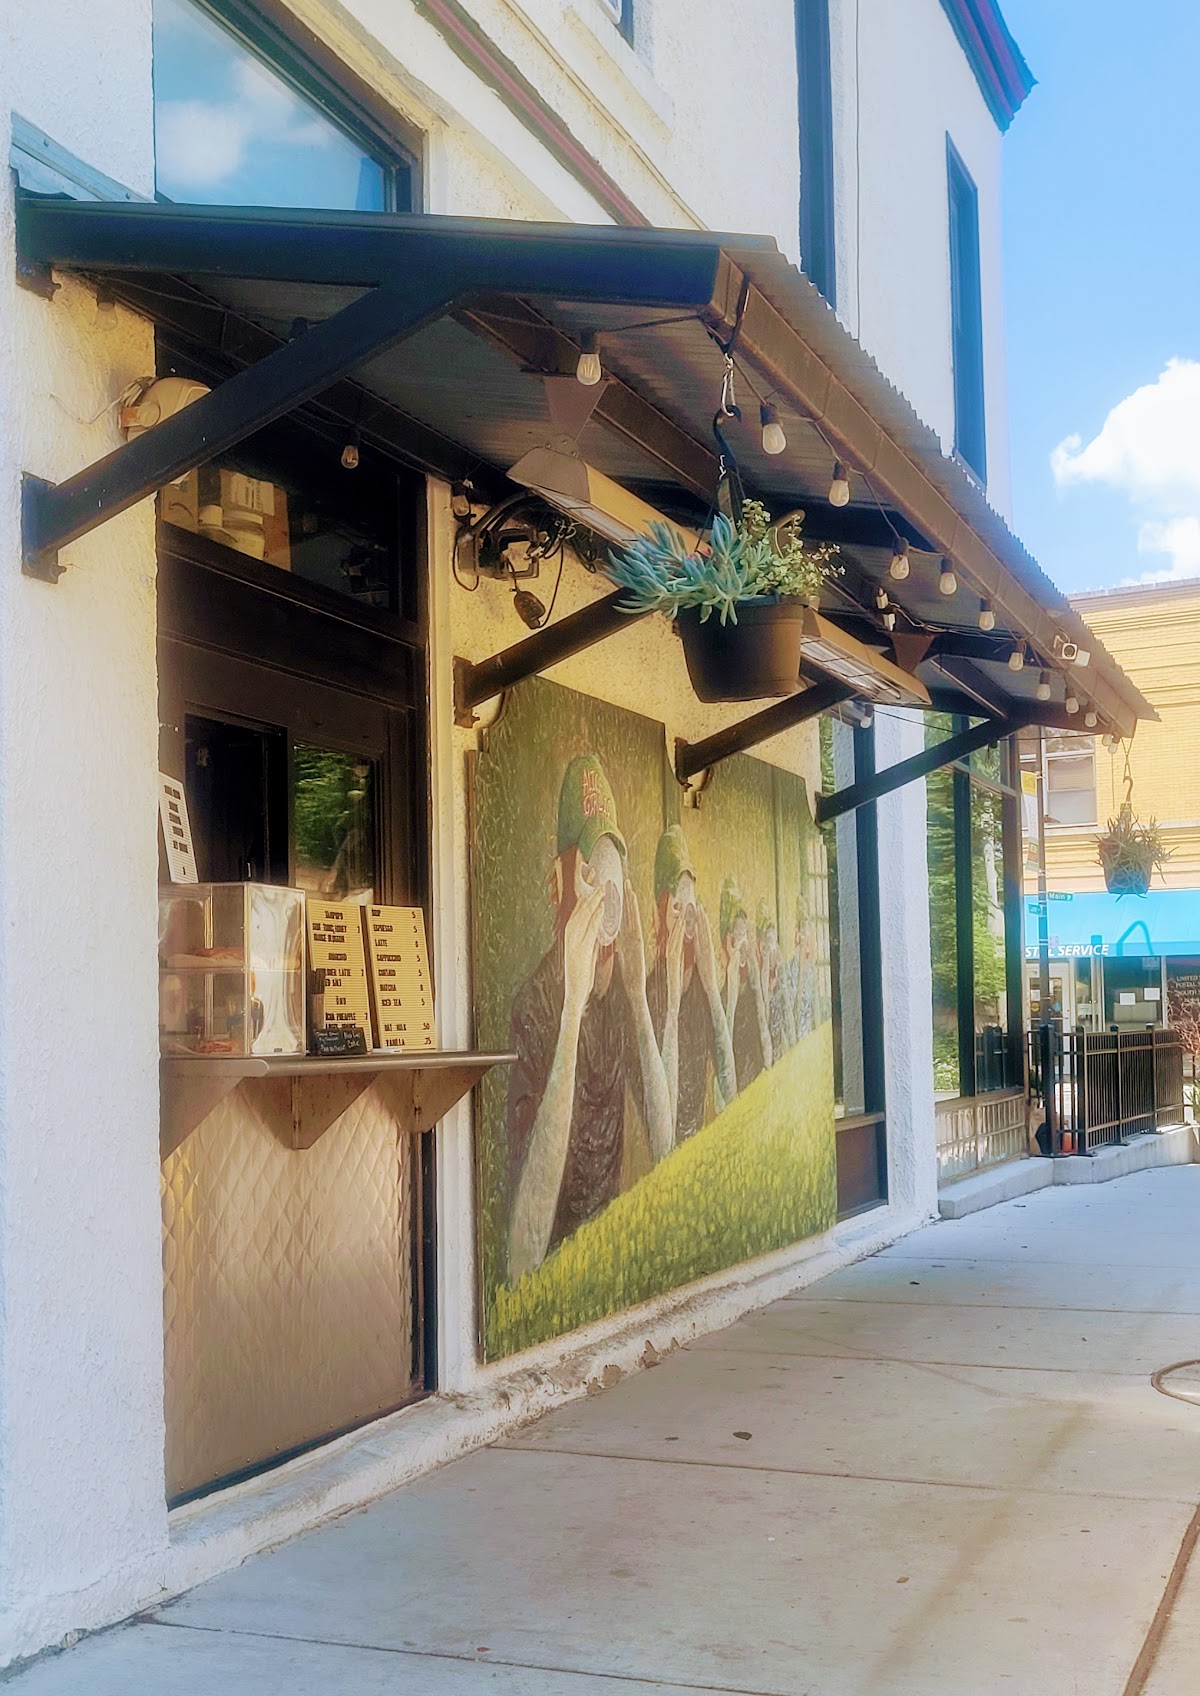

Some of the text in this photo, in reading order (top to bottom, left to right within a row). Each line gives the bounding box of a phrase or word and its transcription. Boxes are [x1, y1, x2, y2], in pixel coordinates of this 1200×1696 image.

[1048, 892, 1065, 900] Main
[412, 911, 416, 919] 5
[373, 924, 418, 933] ESPRESSO 5
[375, 939, 388, 947] LATTE
[1024, 944, 1109, 958] STL SERVICE
[377, 954, 421, 963] CAPPUCCINO 5
[338, 968, 351, 977] LATTE
[378, 969, 422, 977] CORTADO 5
[379, 984, 397, 992] MATCHA
[381, 998, 426, 1007] ICED TEA 5
[336, 1012, 356, 1021] PINEAPPLE
[385, 1038, 406, 1047] VANILLA
